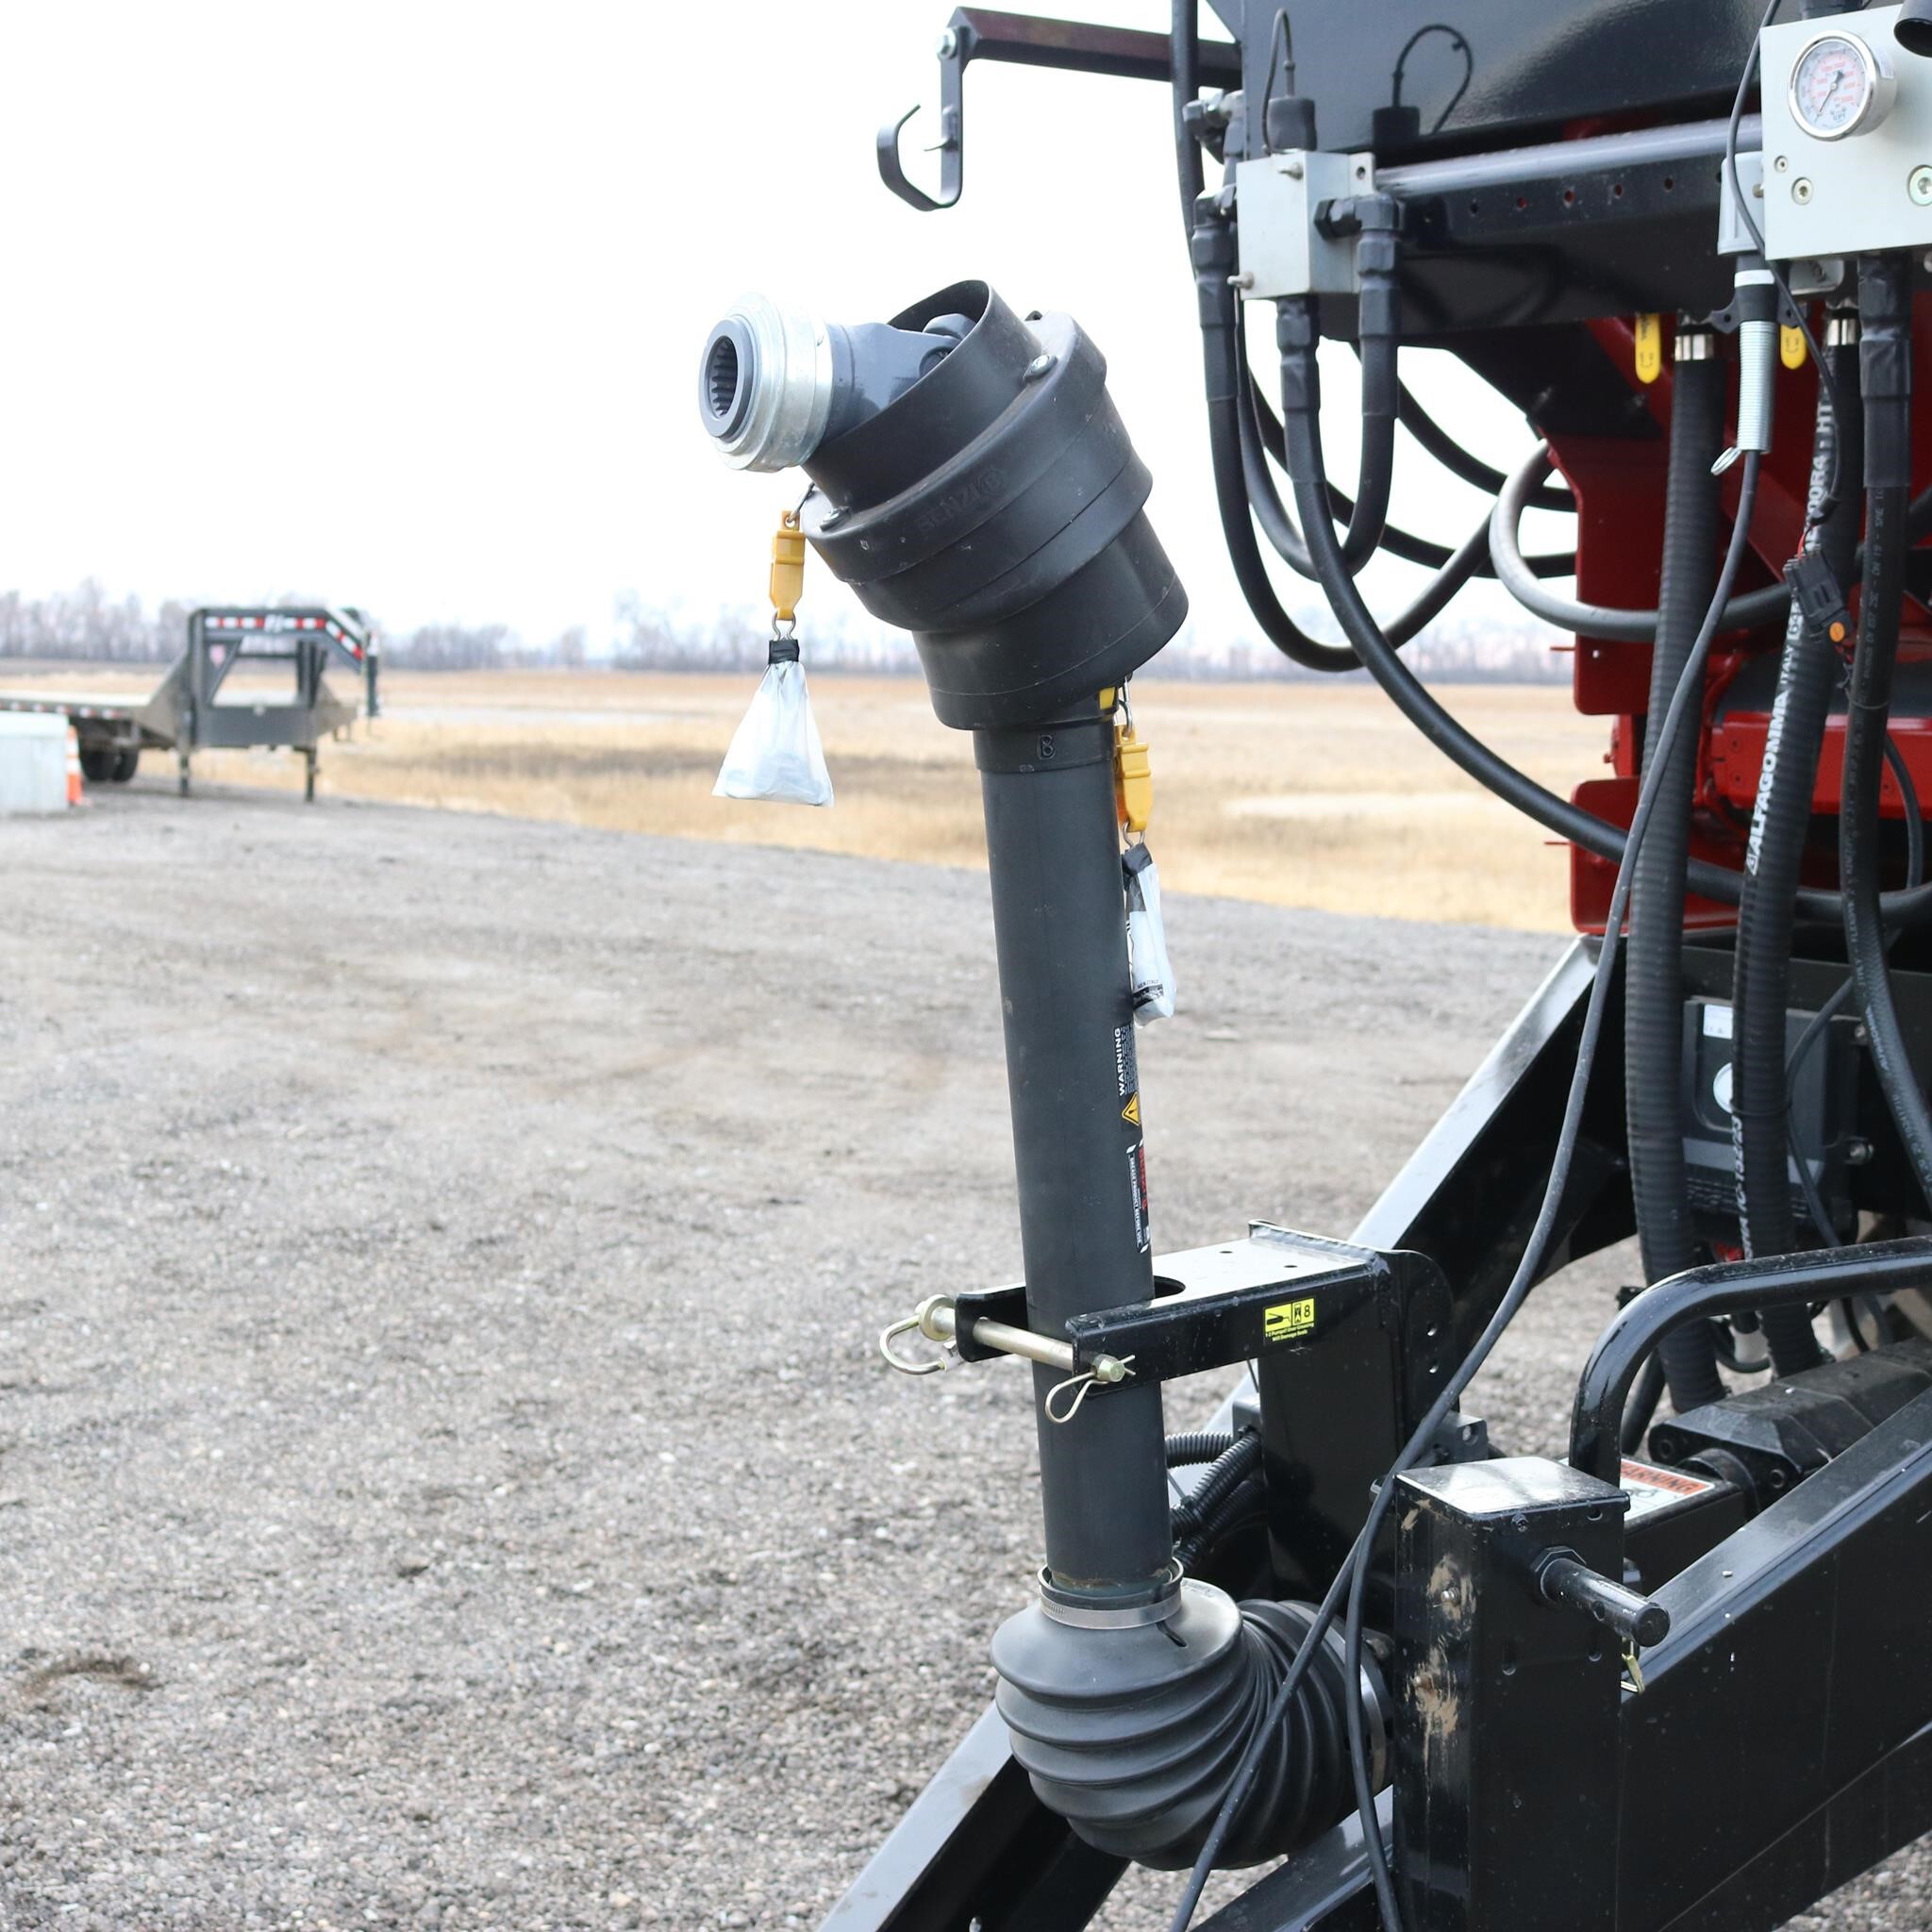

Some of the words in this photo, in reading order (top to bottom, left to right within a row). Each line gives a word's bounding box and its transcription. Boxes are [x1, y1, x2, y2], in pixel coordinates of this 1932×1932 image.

[1749, 690, 1790, 856] ALFAGOMMA
[1780, 644, 1797, 685] ITALY
[1114, 1027, 1125, 1096] WARNING
[1304, 1304, 1311, 1318] 8
[1621, 1461, 1699, 1492] ARNING
